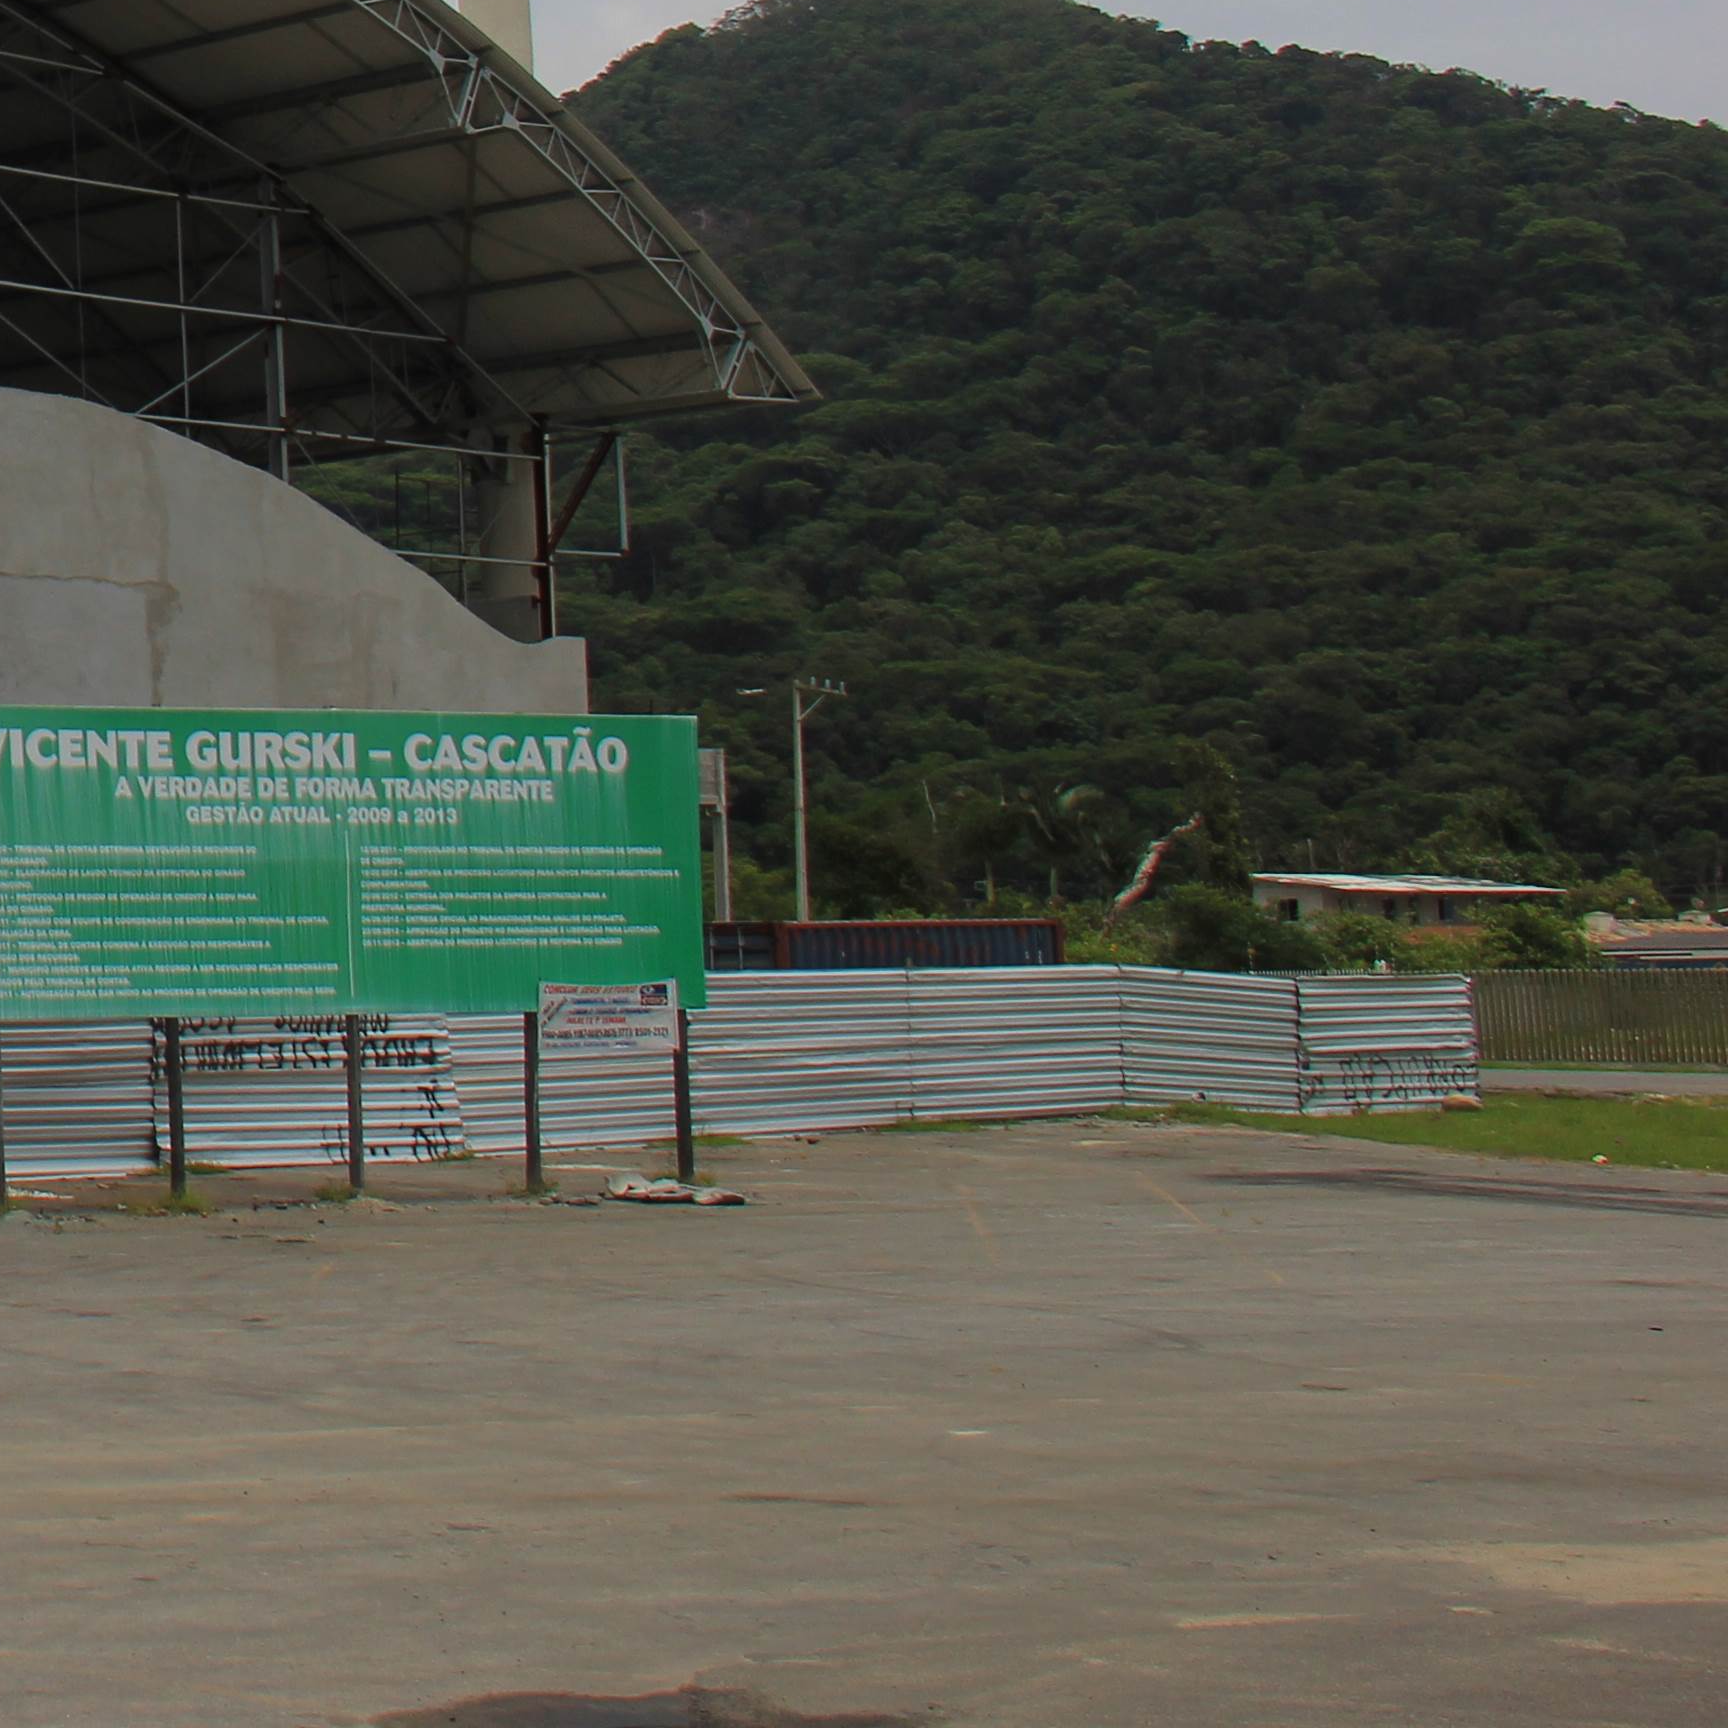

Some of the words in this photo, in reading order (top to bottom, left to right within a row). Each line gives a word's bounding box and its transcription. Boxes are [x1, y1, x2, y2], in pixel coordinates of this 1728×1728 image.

[186, 731, 356, 770] GURSKI
[404, 728, 627, 773] CASCATÃO
[115, 778, 131, 798] A
[136, 778, 251, 800] VERDADE
[258, 779, 289, 800] DE
[295, 779, 376, 800] FORMA
[381, 778, 553, 801] TRANSPARENTE
[186, 802, 264, 824] GESTÃO
[271, 807, 329, 824] ATUAL
[347, 807, 392, 824] 2009
[399, 811, 408, 824] a
[415, 807, 457, 824] 2013
